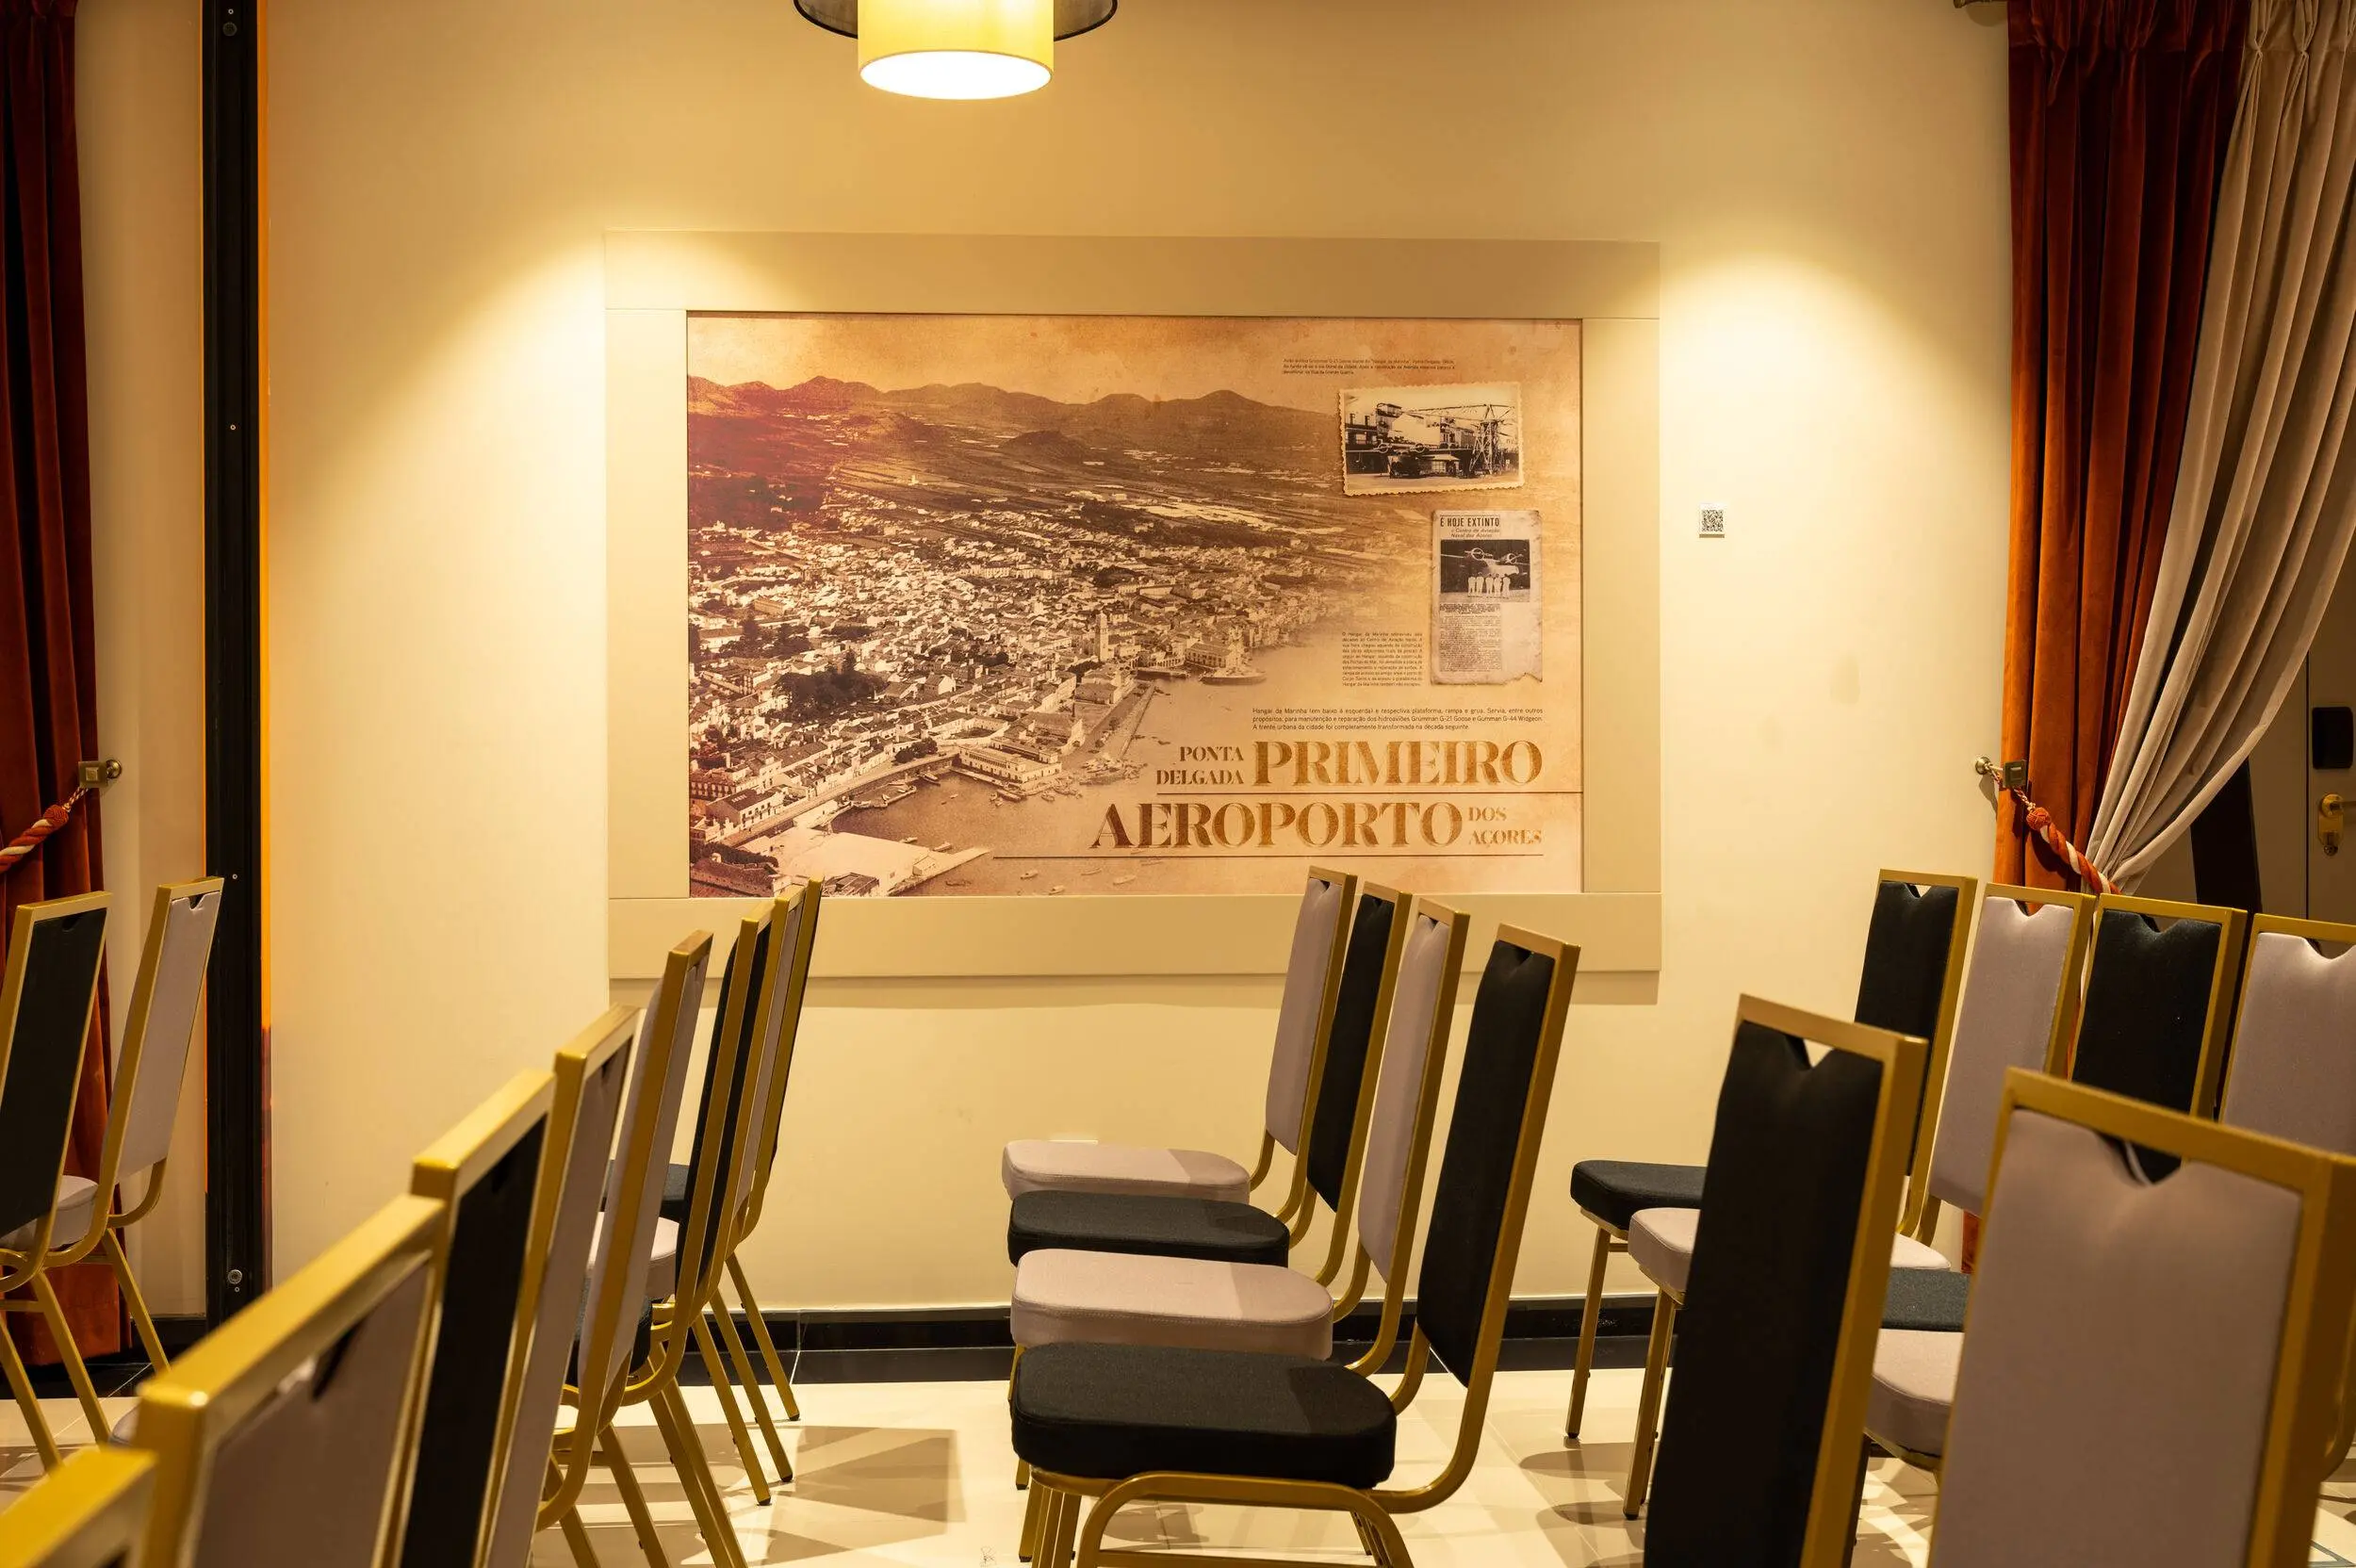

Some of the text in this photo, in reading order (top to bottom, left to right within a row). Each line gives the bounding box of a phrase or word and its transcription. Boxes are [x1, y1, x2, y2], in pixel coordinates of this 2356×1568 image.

[1447, 517, 1464, 527] HOJE
[1468, 517, 1500, 527] EXTINTO
[1180, 746, 1244, 761] PONTA
[1252, 740, 1543, 787] PRIMEIRO
[1156, 770, 1244, 785] DELGADA
[1468, 806, 1507, 822] DOS
[1089, 802, 1463, 848] AEROPORTO
[1468, 828, 1543, 848] AÇORES
